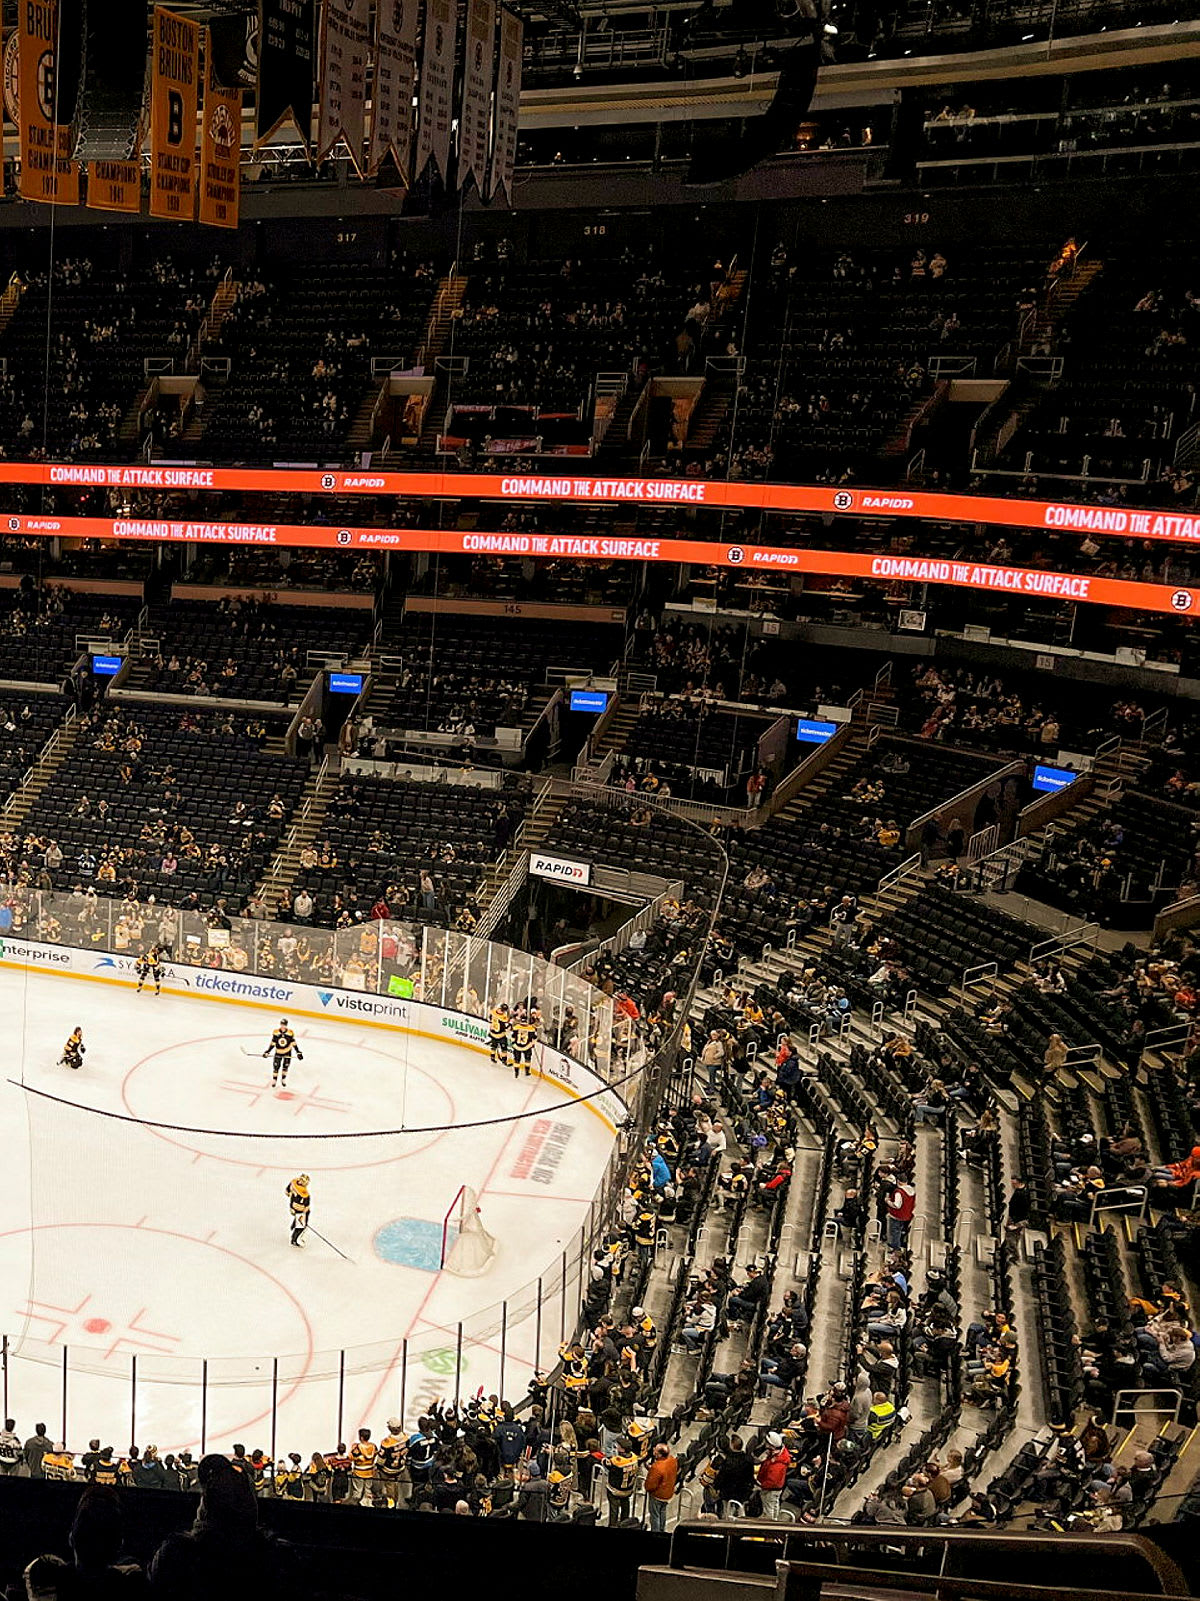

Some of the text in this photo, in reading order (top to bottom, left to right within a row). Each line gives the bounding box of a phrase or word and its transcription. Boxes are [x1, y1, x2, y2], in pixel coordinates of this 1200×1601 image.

[159, 14, 194, 53] BOSTON
[159, 46, 193, 85] BRUINS
[95, 161, 137, 184] CHAMPIONS
[337, 232, 357, 242] 317
[50, 467, 213, 486] COMMAND THE ATTACK SURFACE
[501, 478, 705, 500] COMMAND THE ATTACK SURFACE
[113, 521, 276, 542] COMMAND THE ATTACK SURFACE
[1045, 506, 1200, 539] COMMAND THE ATTAC
[462, 534, 660, 557] COMMAND THE ATTACK SURFACE
[871, 558, 1090, 598] COMMAND THE ATTACK SURFACE
[535, 860, 583, 880] RAPID7
[195, 973, 293, 1001] ticketmaster
[336, 995, 406, 1020] vistaprint
[442, 1017, 488, 1039] SULLIVAN
